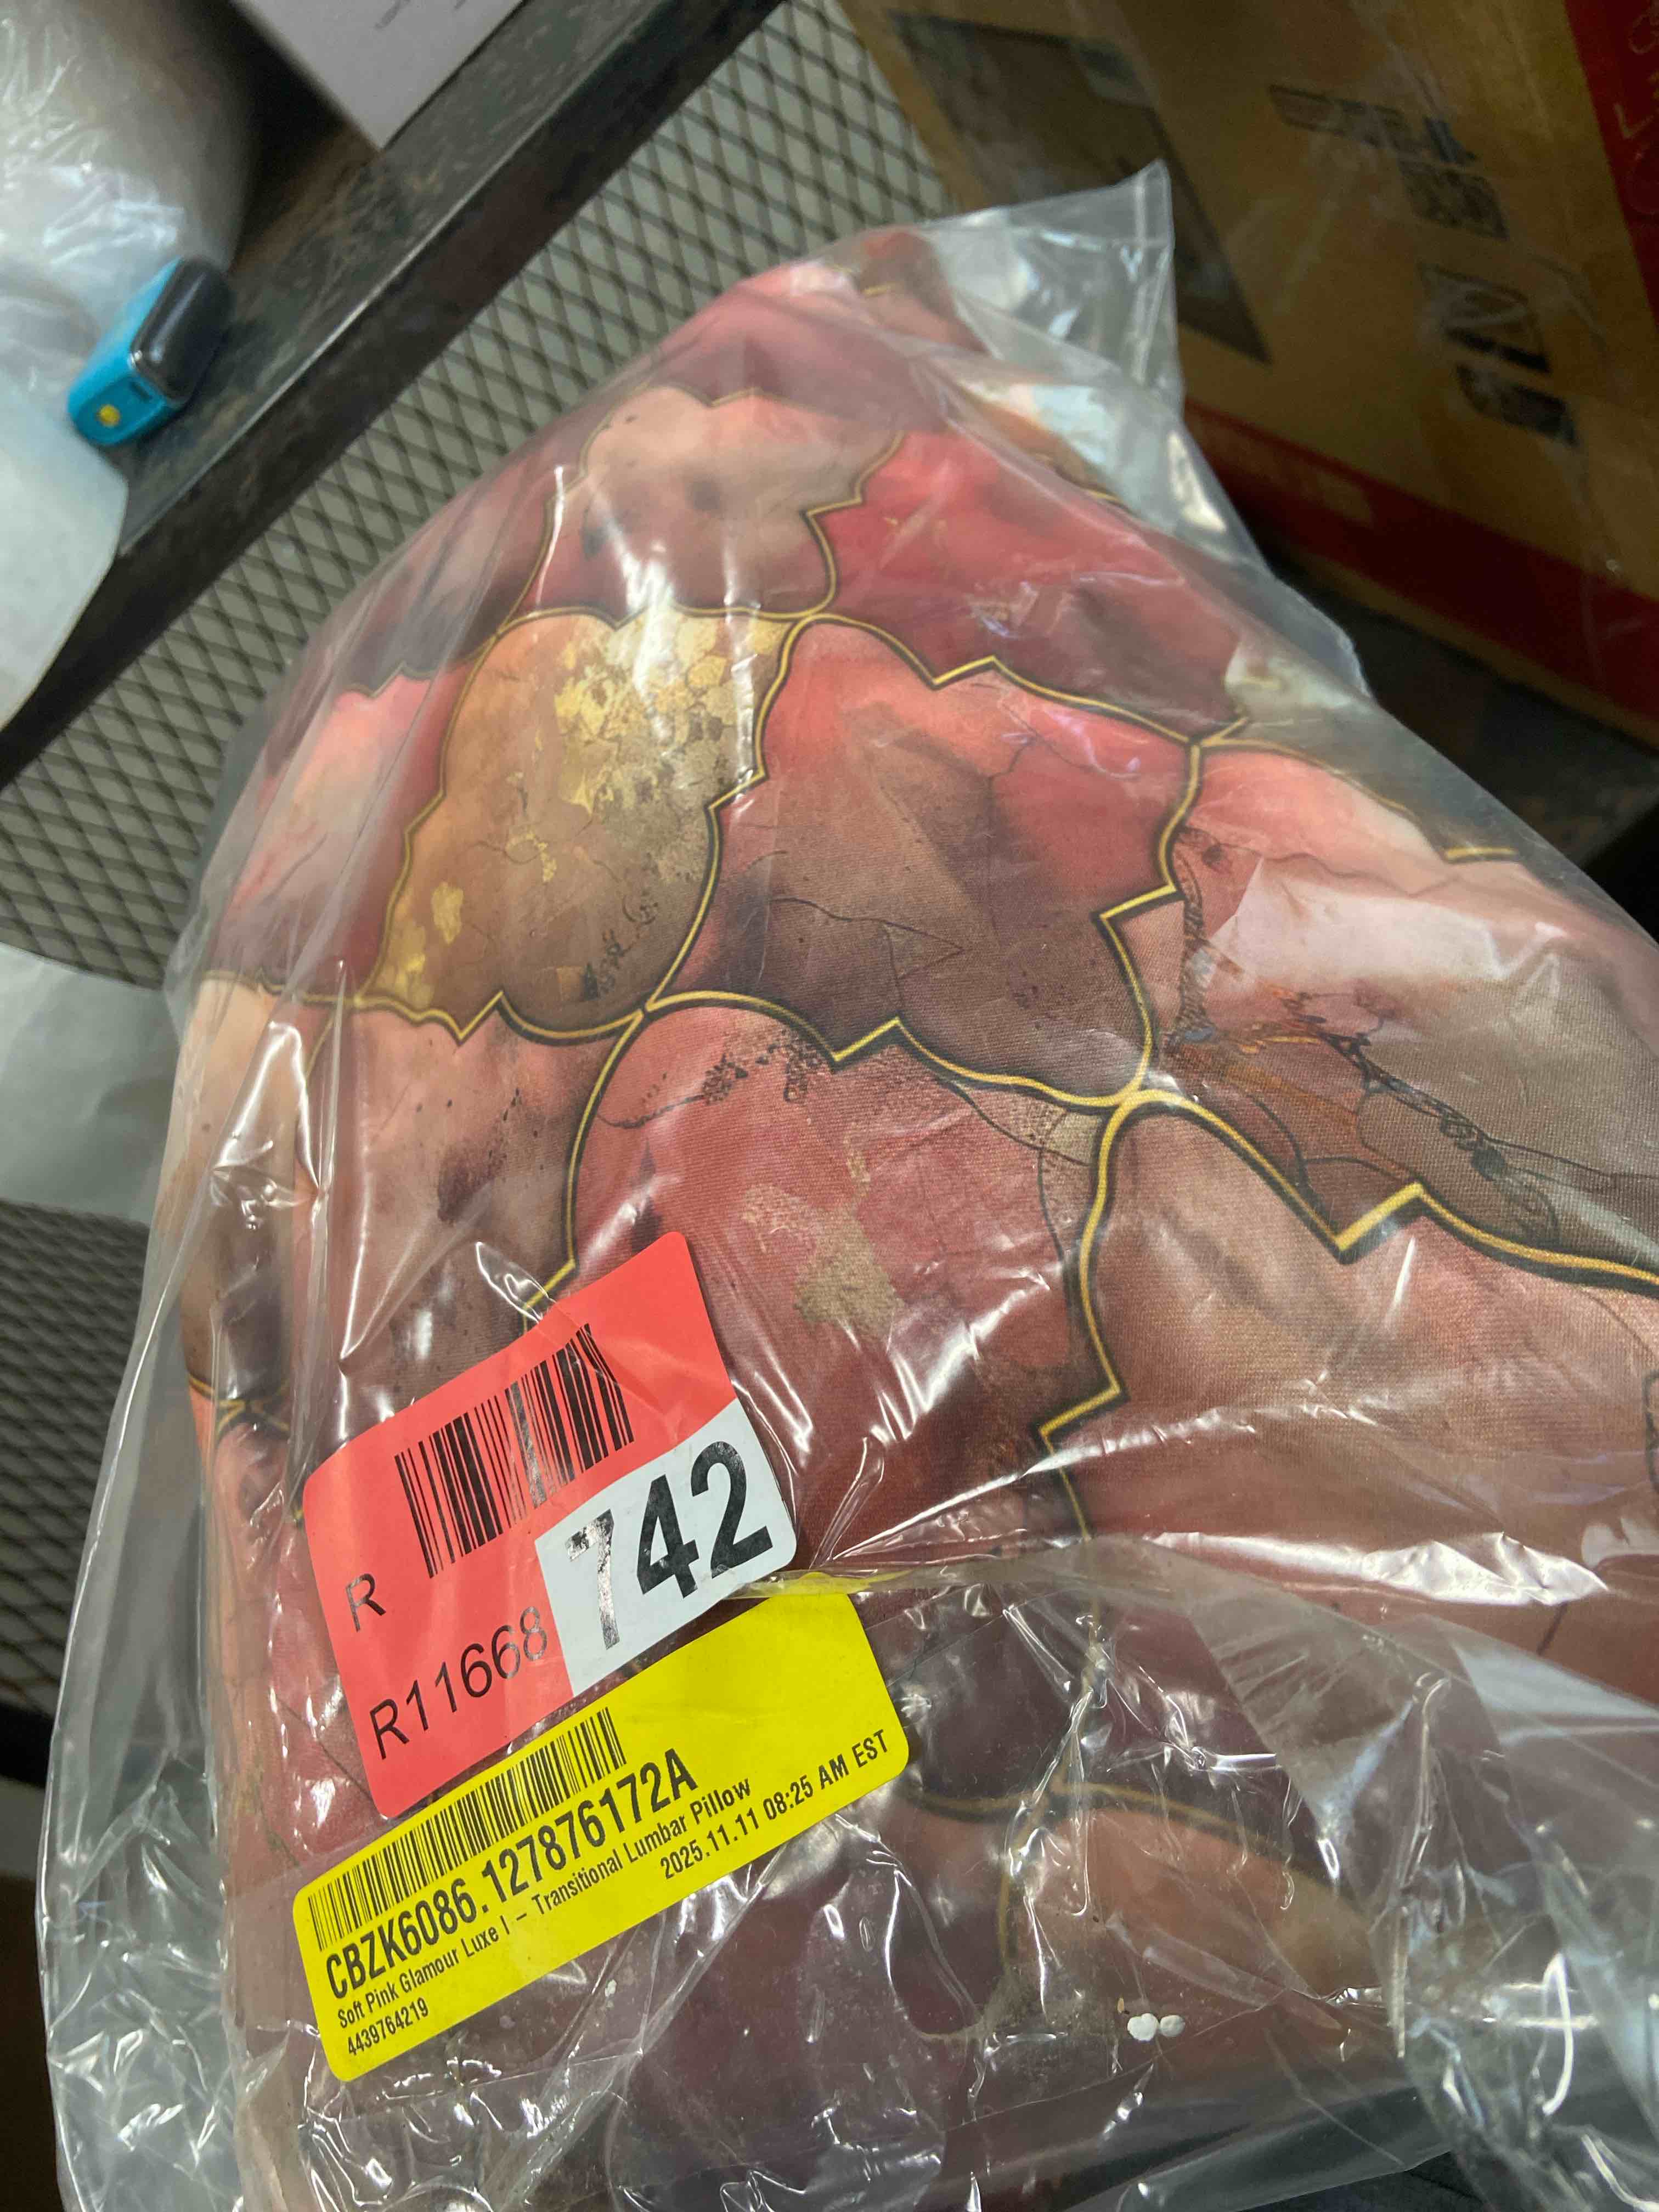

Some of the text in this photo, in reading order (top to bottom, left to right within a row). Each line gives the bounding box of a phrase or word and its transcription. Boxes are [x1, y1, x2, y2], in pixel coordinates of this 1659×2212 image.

[346, 1573, 386, 1632] R
[326, 1748, 698, 1999] CBZK6086.127876172A
[661, 1729, 887, 1879] 2025.11.11 08:25 AM EST
[337, 2002, 365, 2028] Soft
[365, 1980, 399, 2013] Pink
[400, 1948, 460, 1994] Glamour
[461, 1927, 499, 1957] Luxe
[532, 1849, 624, 1915] Transitional
[623, 1815, 687, 1863] Lumbar
[690, 1778, 751, 1825] Pillow
[348, 1997, 428, 2056] 4439764219
